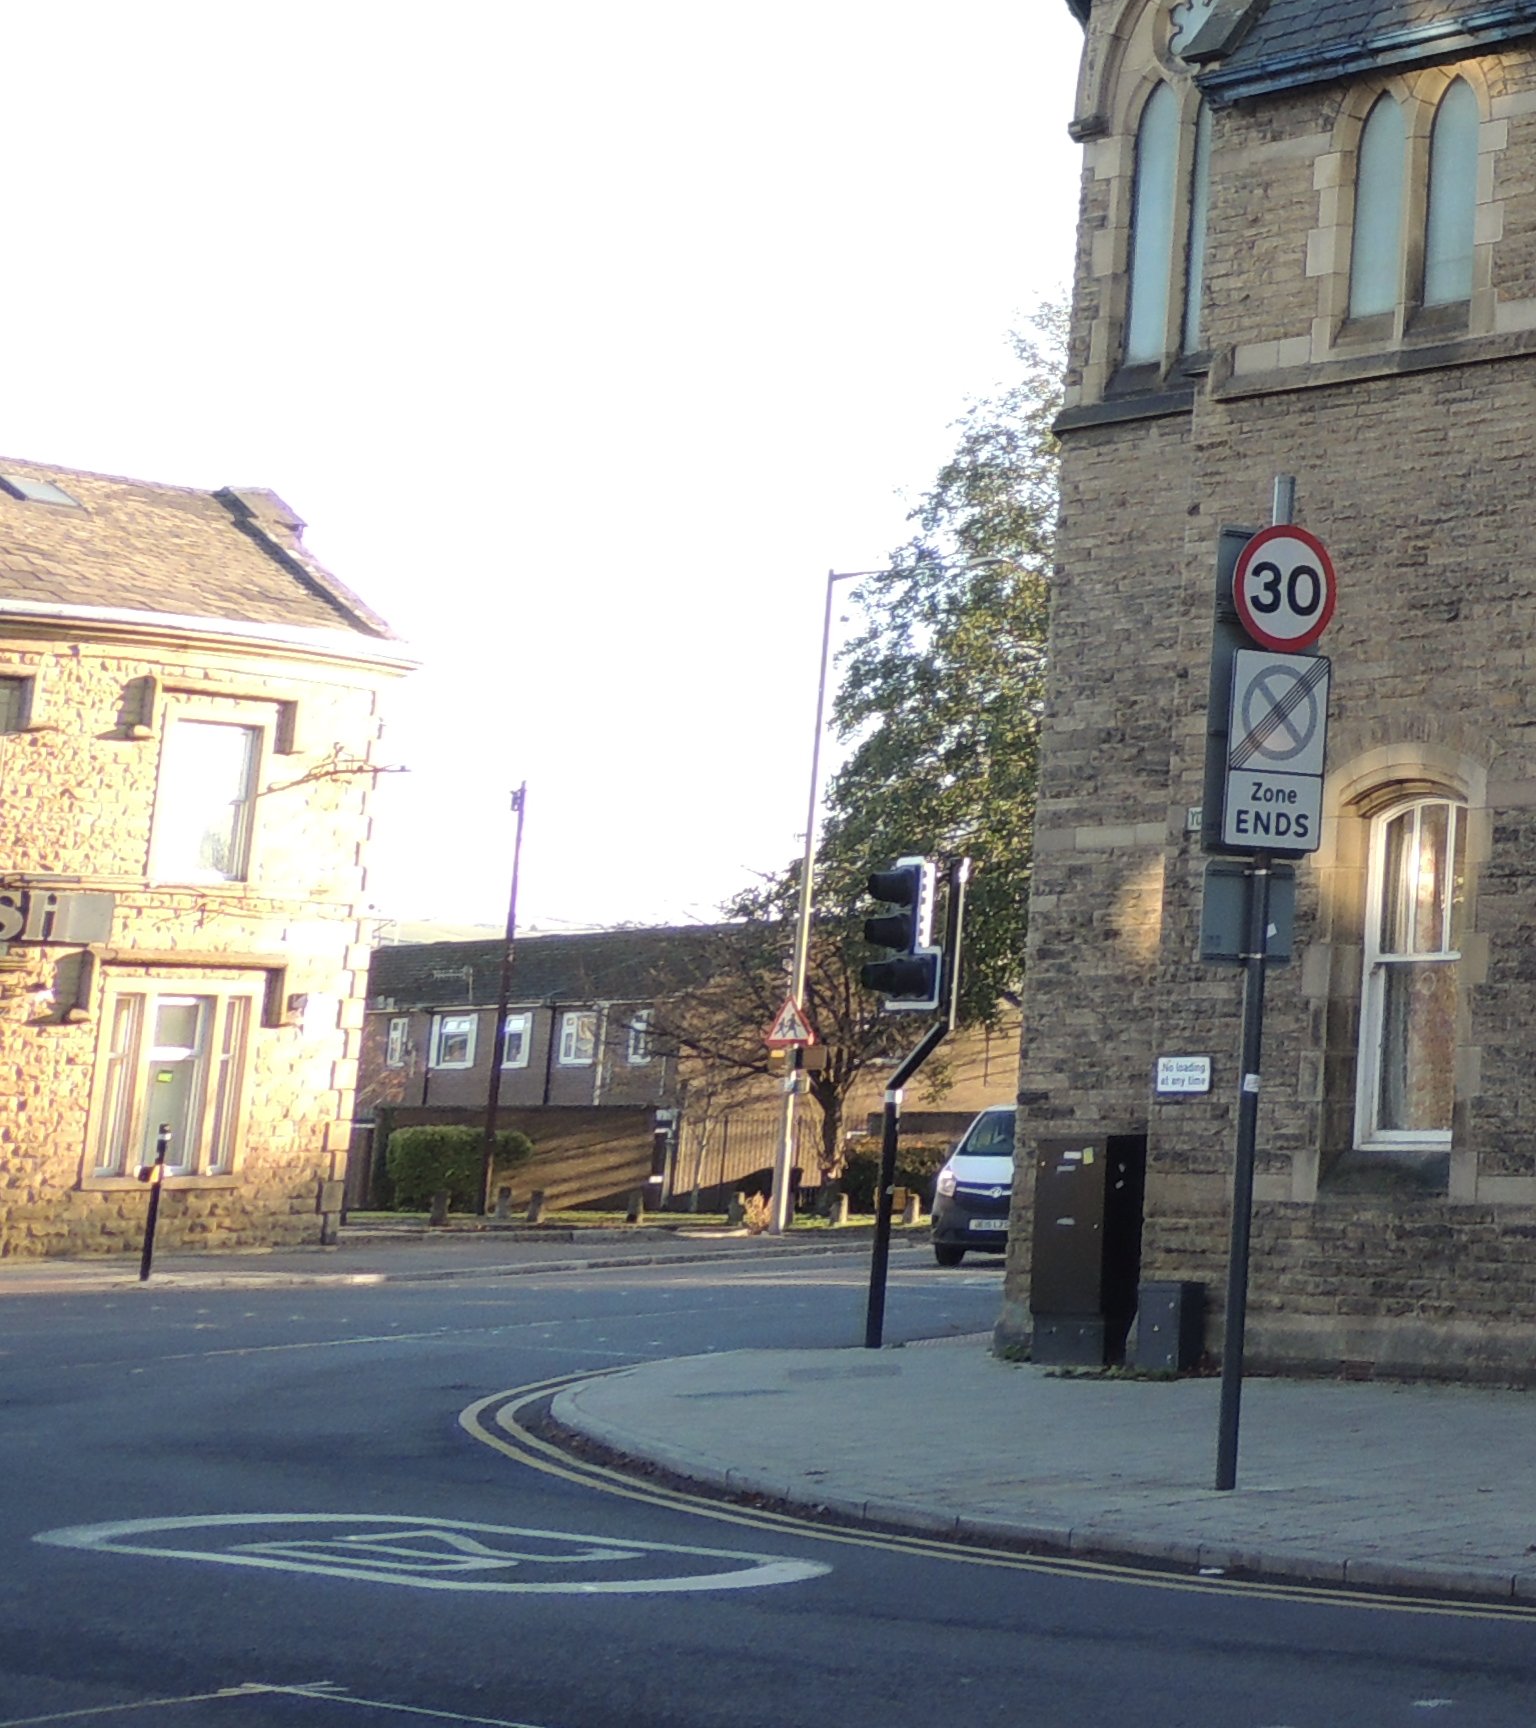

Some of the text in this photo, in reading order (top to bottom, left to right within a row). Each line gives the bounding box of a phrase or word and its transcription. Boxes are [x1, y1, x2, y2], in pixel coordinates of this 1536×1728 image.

[1249, 561, 1321, 617] 30
[1250, 782, 1298, 805] Zone
[1235, 809, 1310, 838] ENDS
[1161, 1062, 1205, 1074] No loading
[1160, 1075, 1206, 1087] at any time
